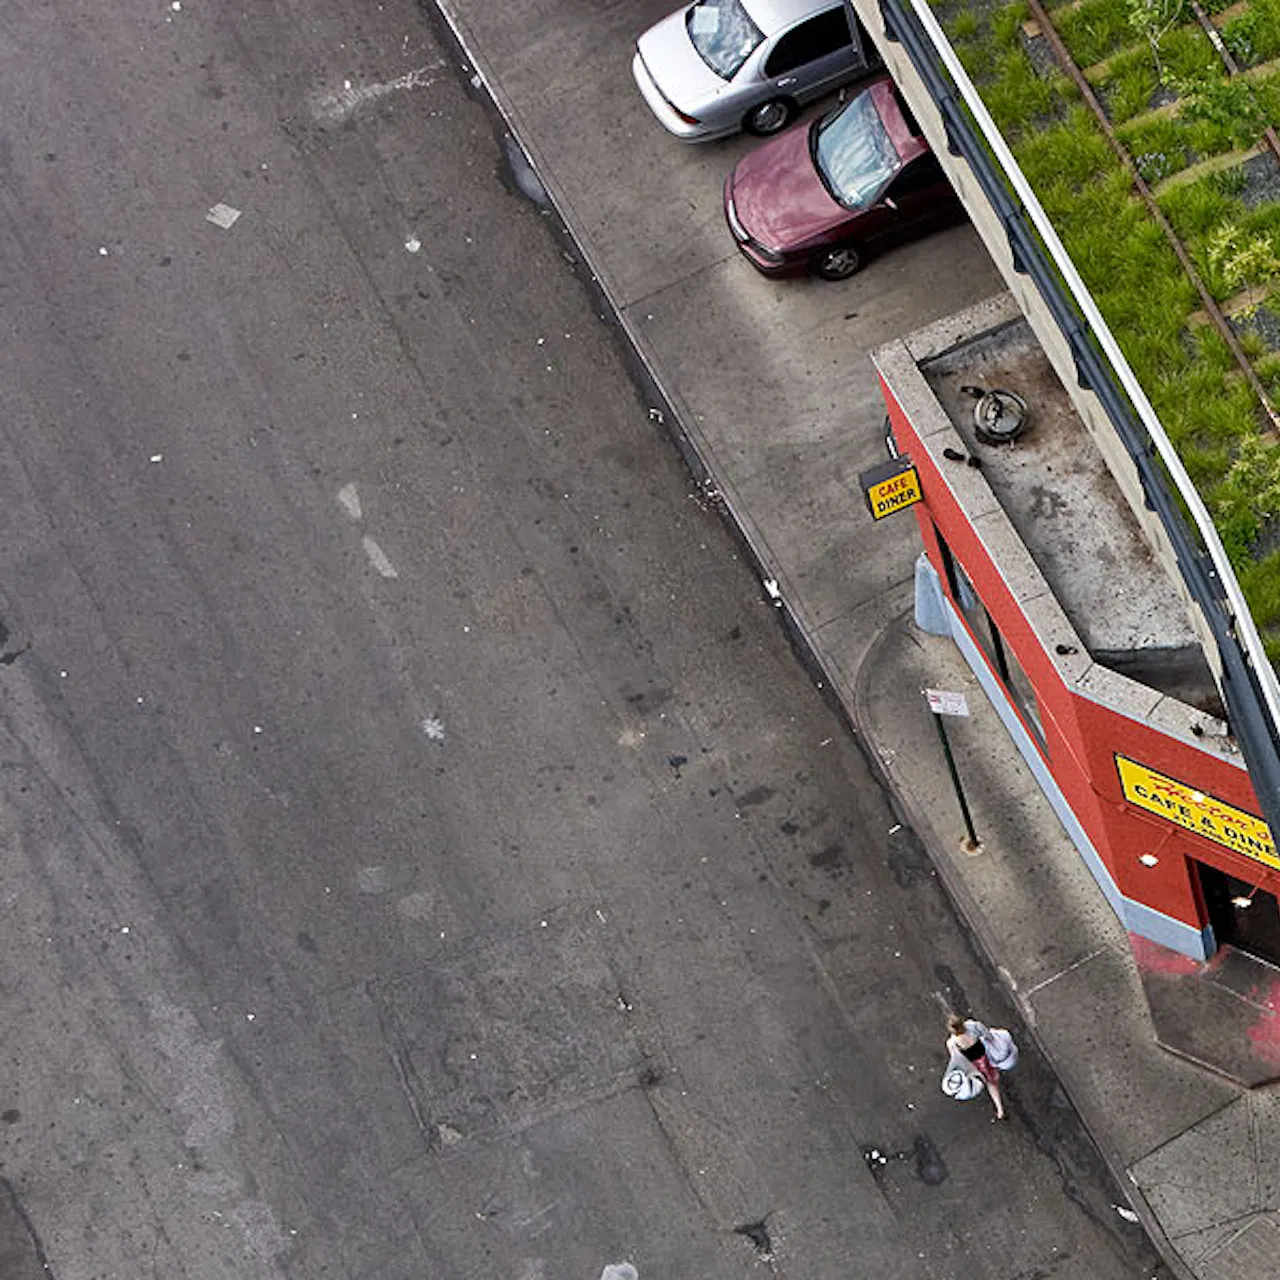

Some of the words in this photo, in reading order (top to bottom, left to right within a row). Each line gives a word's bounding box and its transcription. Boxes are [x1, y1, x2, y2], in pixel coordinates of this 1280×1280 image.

[879, 478, 907, 497] CAFE
[877, 488, 916, 512] DINER
[1134, 785, 1192, 819] CAFE
[1224, 825, 1279, 857] DINE
